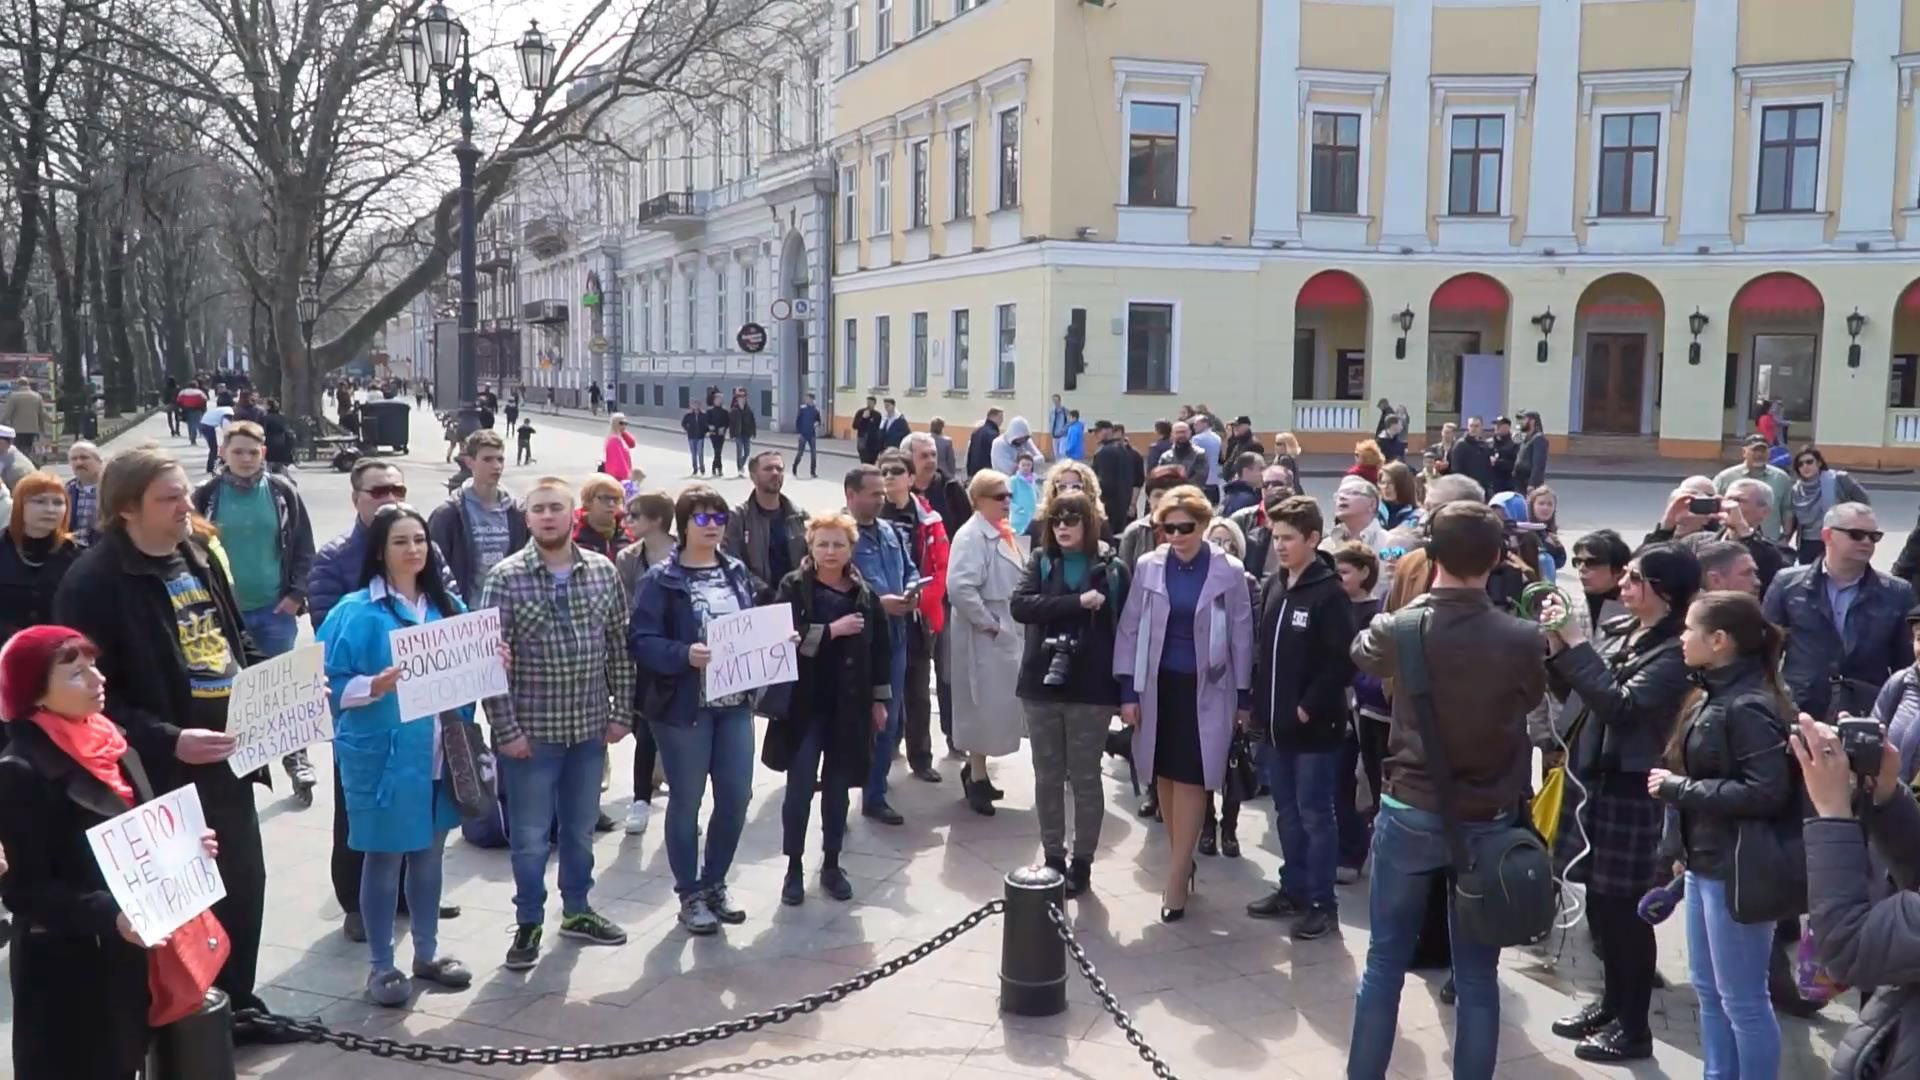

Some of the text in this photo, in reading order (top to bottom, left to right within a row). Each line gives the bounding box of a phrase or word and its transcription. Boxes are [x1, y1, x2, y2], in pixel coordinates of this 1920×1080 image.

[713, 642, 791, 691] ЖИТТЯ
[236, 720, 326, 770] ПРАЗДНИК
[123, 859, 159, 893] НЕ
